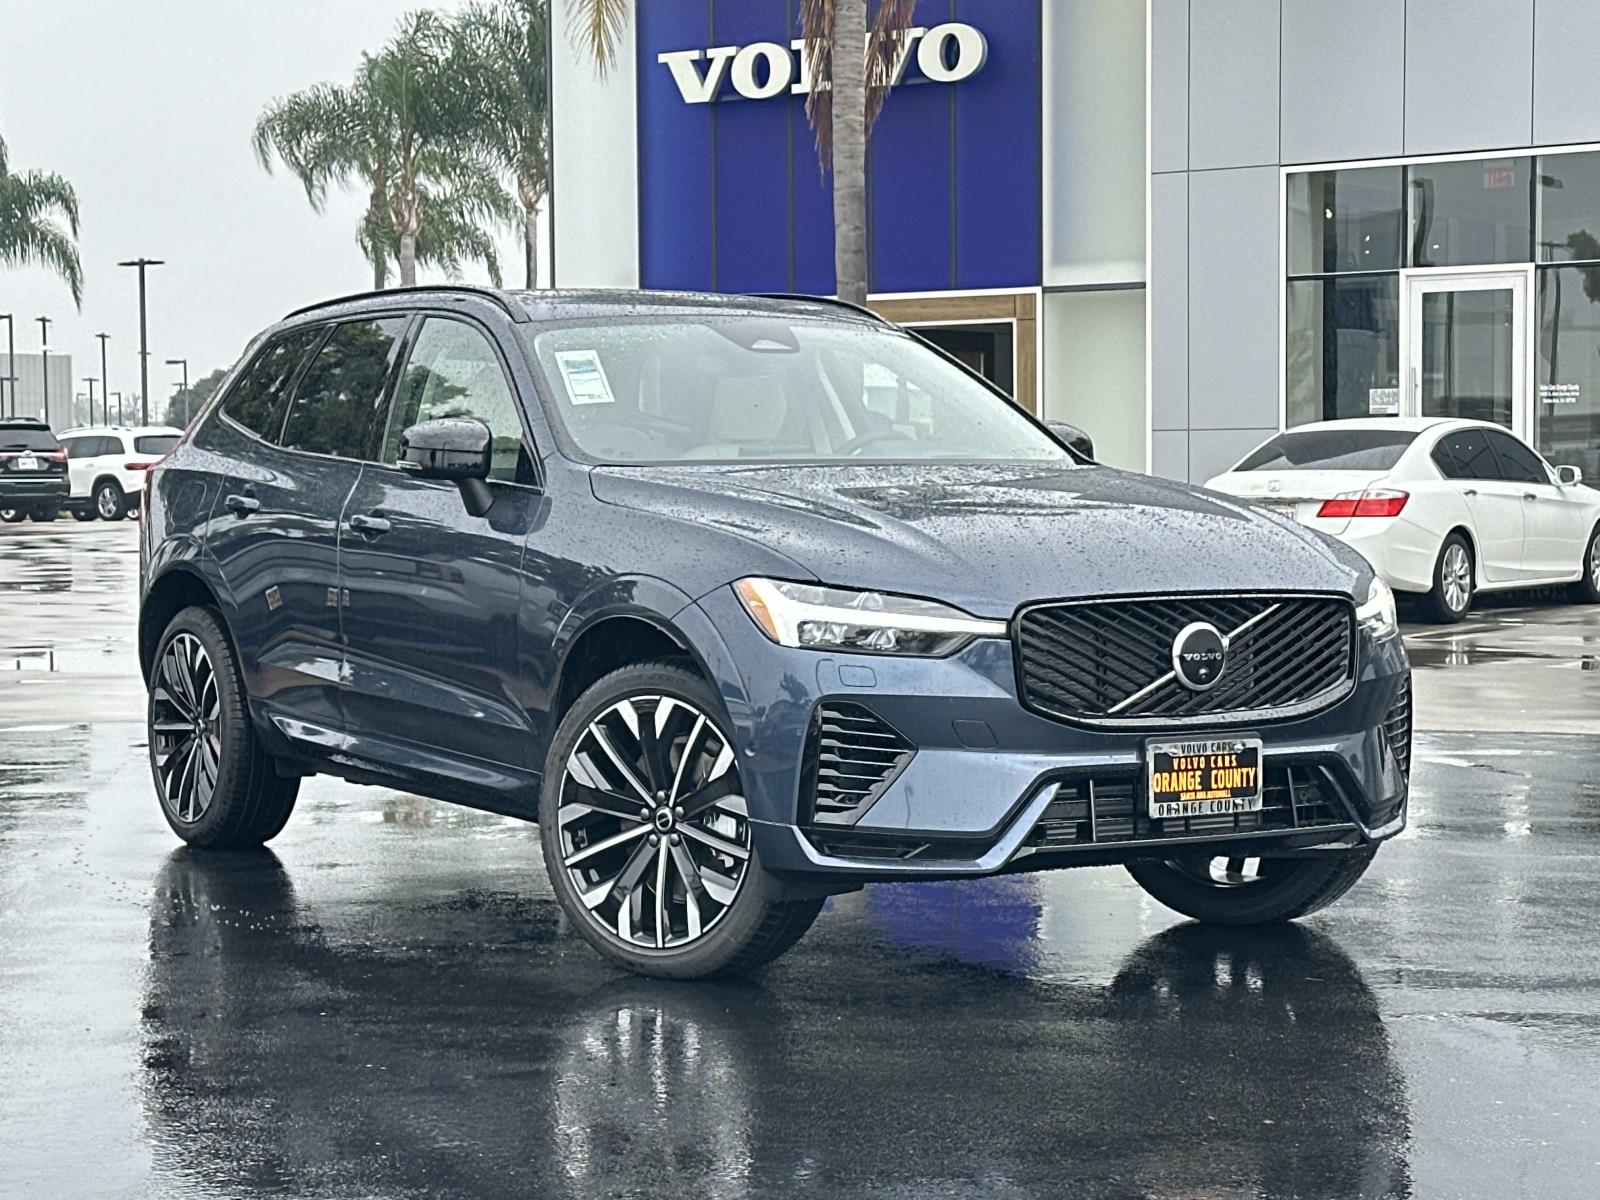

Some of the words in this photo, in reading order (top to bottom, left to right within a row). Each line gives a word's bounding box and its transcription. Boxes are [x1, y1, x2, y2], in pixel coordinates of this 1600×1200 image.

[1181, 743, 1207, 754] VOLVO
[1173, 756, 1205, 770] VOLVO
[1210, 754, 1237, 768] CARS
[1153, 771, 1202, 792] ORANGE
[1211, 767, 1256, 789] COUNTY
[1158, 801, 1204, 816] ORANGE
